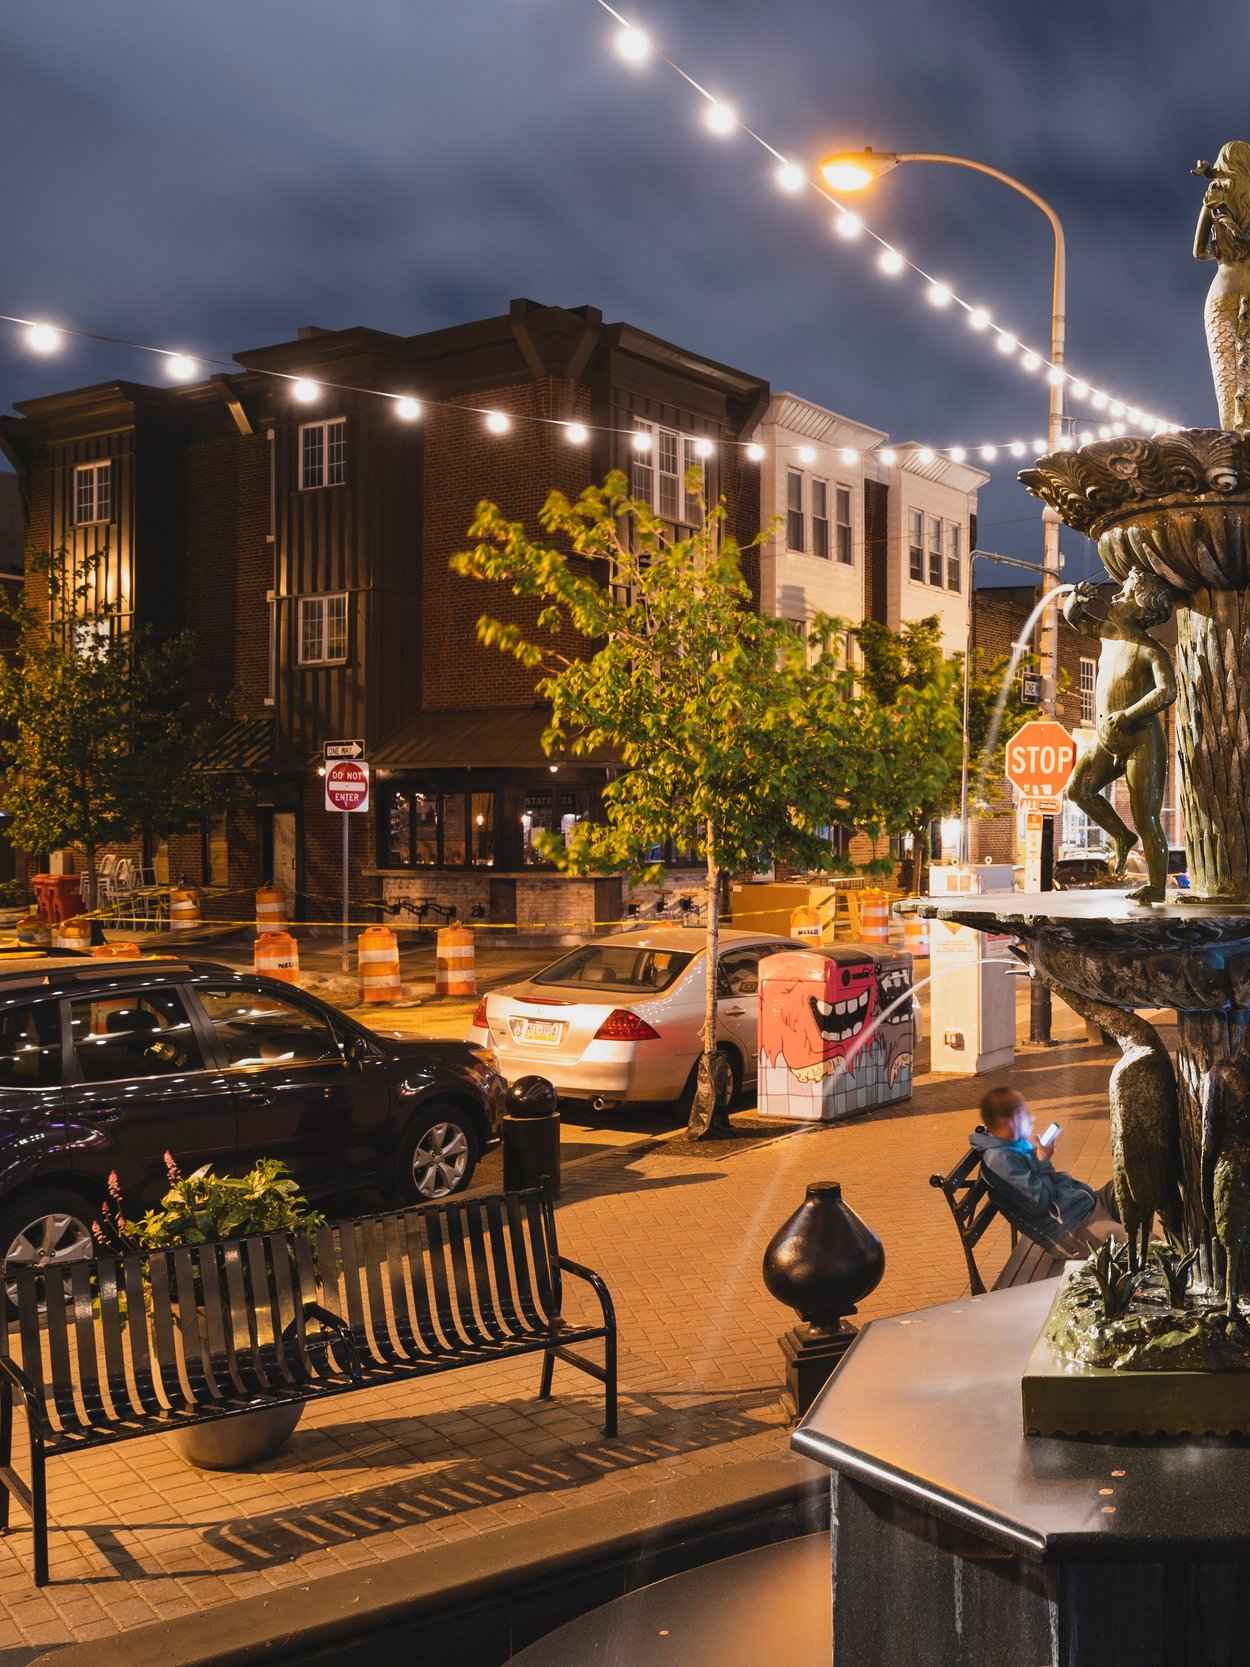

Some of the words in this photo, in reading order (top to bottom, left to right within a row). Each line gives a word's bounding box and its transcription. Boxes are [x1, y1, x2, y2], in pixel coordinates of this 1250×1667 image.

[1011, 746, 1073, 774] STOP
[332, 771, 343, 780] DO
[346, 771, 363, 780] NOT
[335, 793, 360, 801] ENTER
